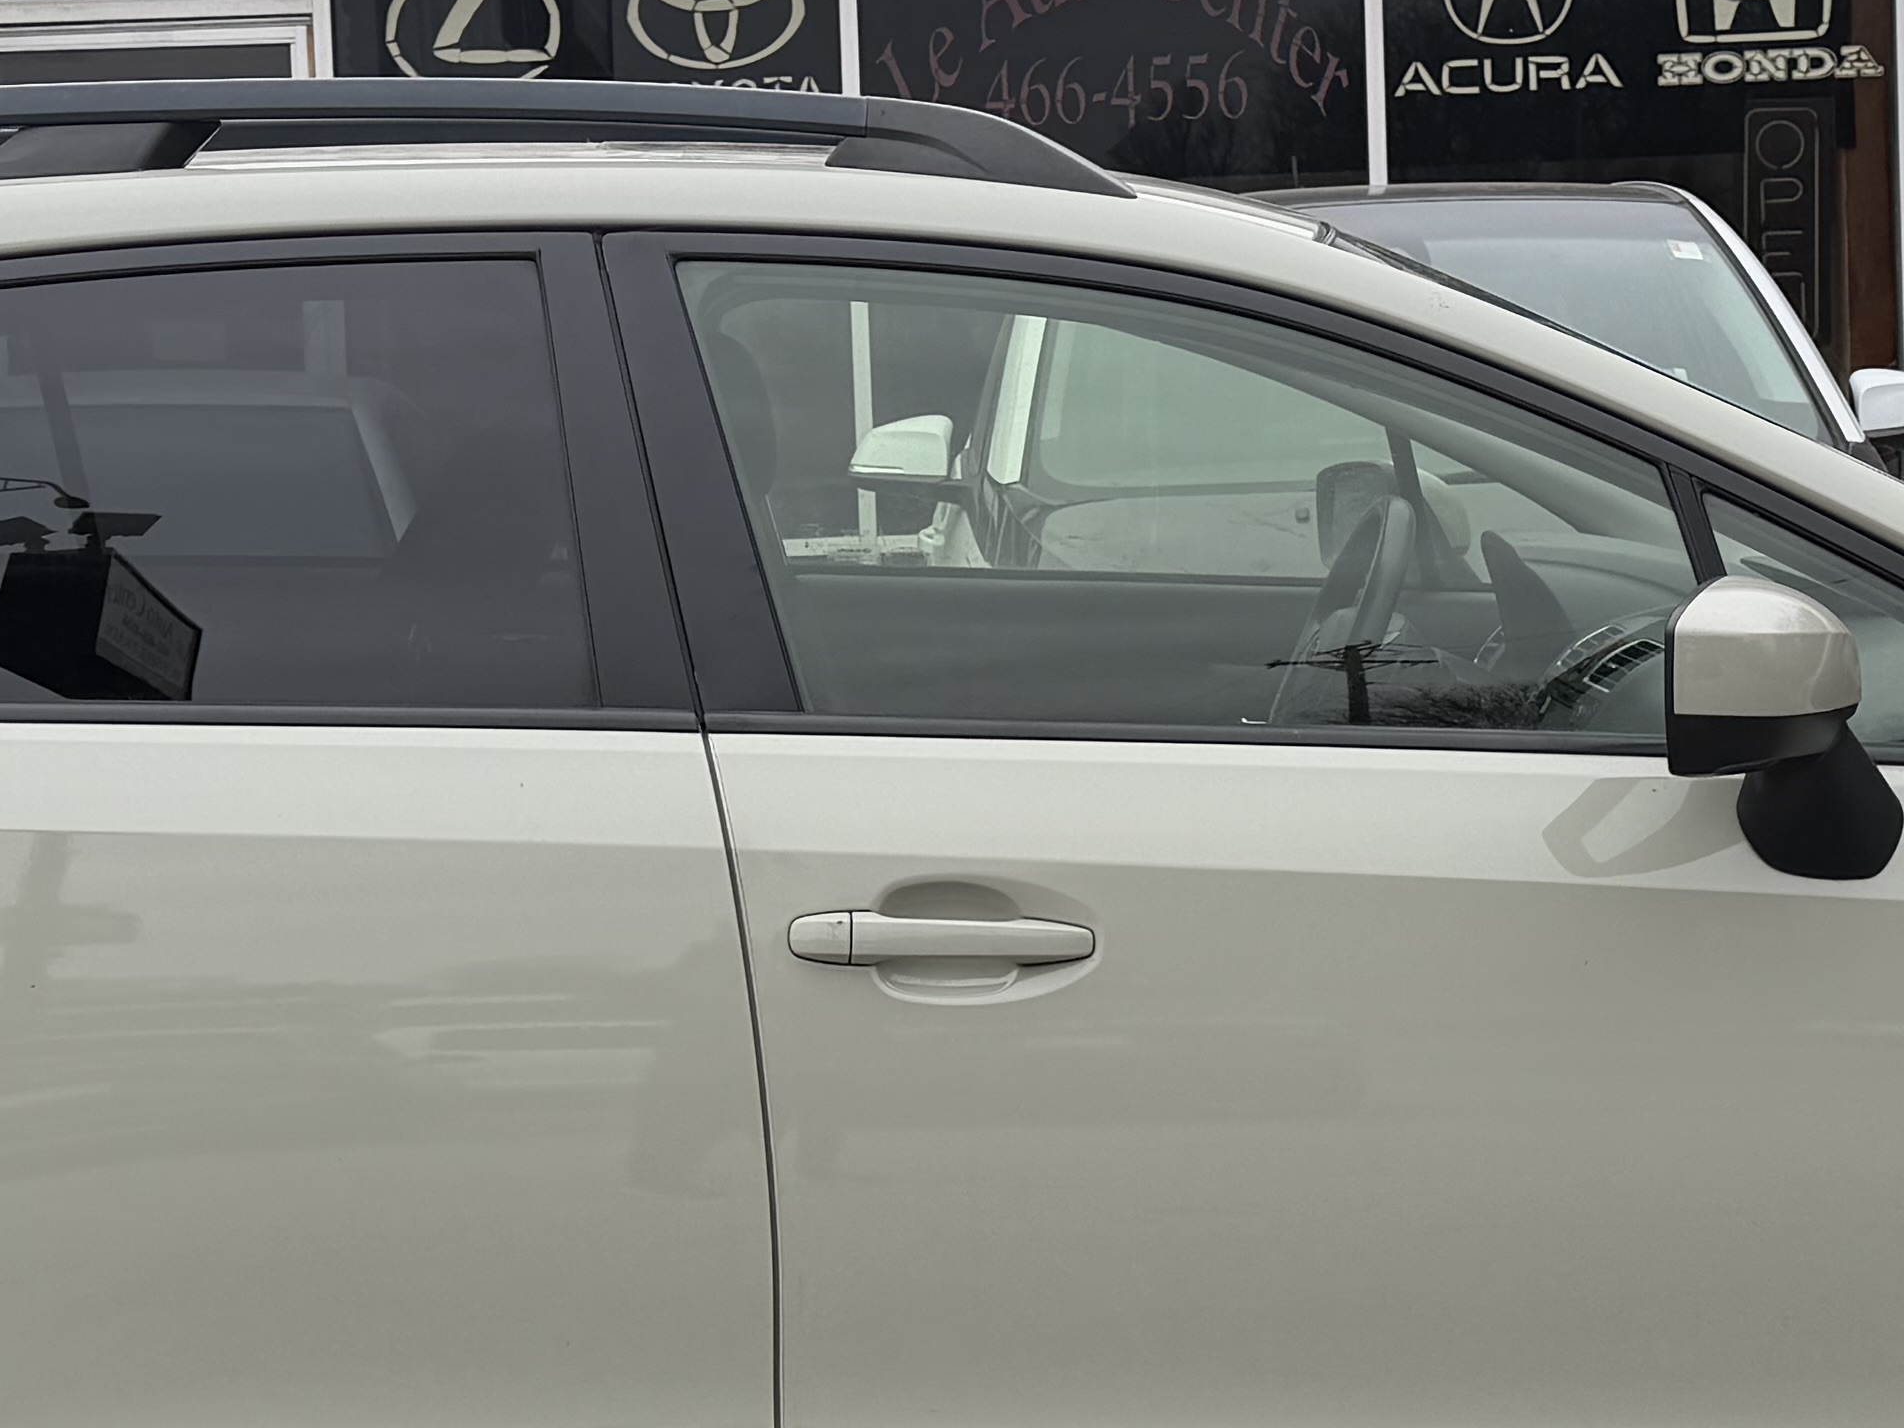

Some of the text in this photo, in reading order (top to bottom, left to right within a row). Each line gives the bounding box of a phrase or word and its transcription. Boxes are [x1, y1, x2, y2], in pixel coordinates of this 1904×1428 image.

[1394, 53, 1623, 97] ACURA
[1657, 45, 1884, 87] HONDA
[985, 50, 1249, 130] 466-4556
